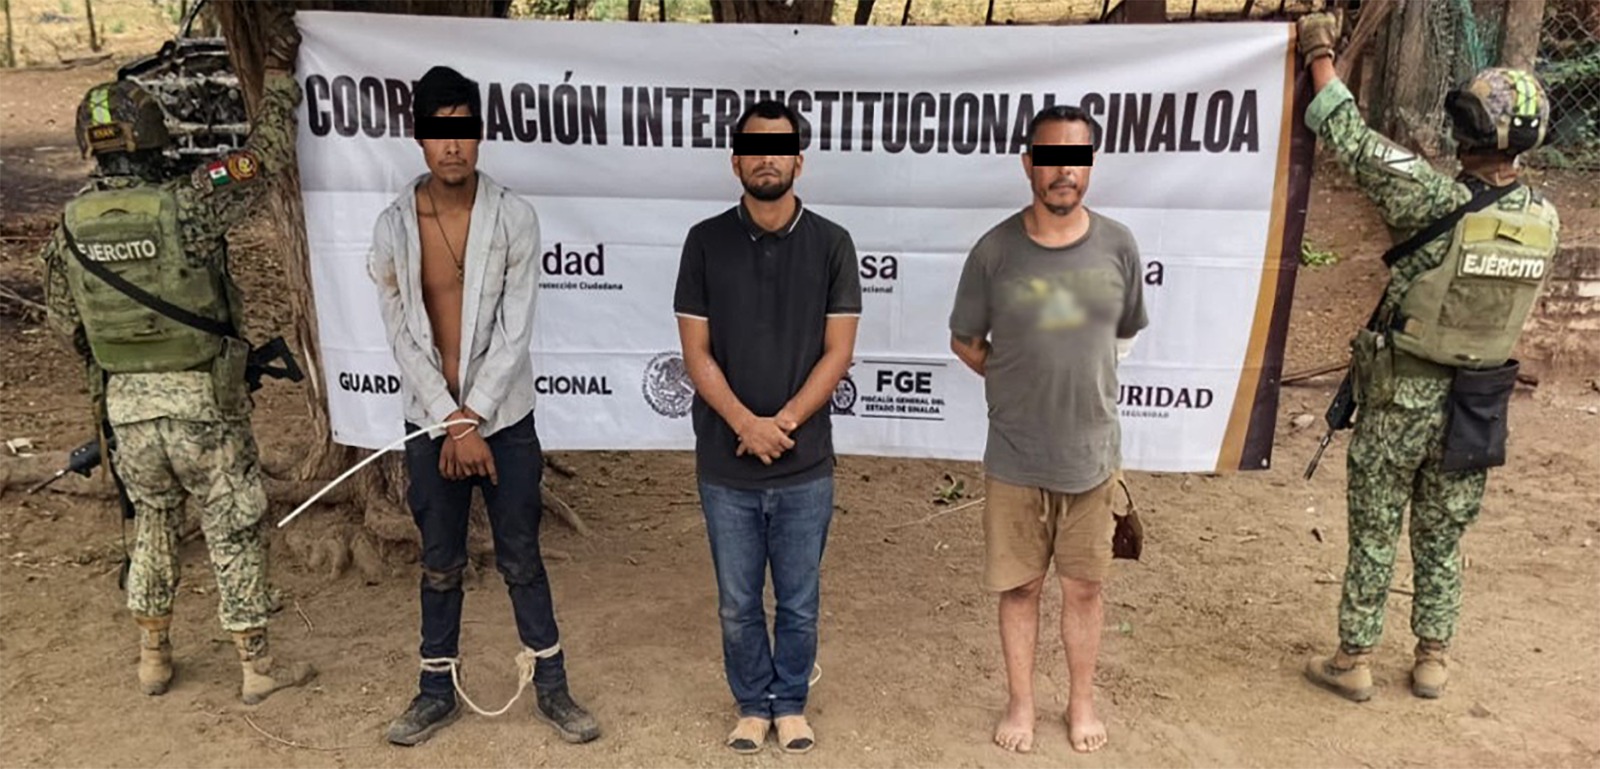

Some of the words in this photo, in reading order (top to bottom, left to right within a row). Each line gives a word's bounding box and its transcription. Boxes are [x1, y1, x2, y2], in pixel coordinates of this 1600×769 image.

[305, 71, 607, 146] COORACIÓN
[622, 85, 1056, 154] INTERSTITUCIONA
[1080, 89, 1260, 154] SINALOA
[542, 242, 604, 276] dad
[860, 254, 898, 280] sa
[1463, 253, 1545, 279] EJÉRCITO
[539, 281, 578, 290] rotección
[862, 285, 893, 294] acional
[338, 371, 401, 394] GUARD
[534, 375, 612, 396] CIONAL
[876, 369, 932, 394] FGE
[895, 396, 929, 405] GENERAL
[1116, 384, 1213, 409] URIDAD
[865, 404, 894, 412] ESTADO
[896, 405, 906, 413] DE
[907, 405, 940, 414] SINALOA
